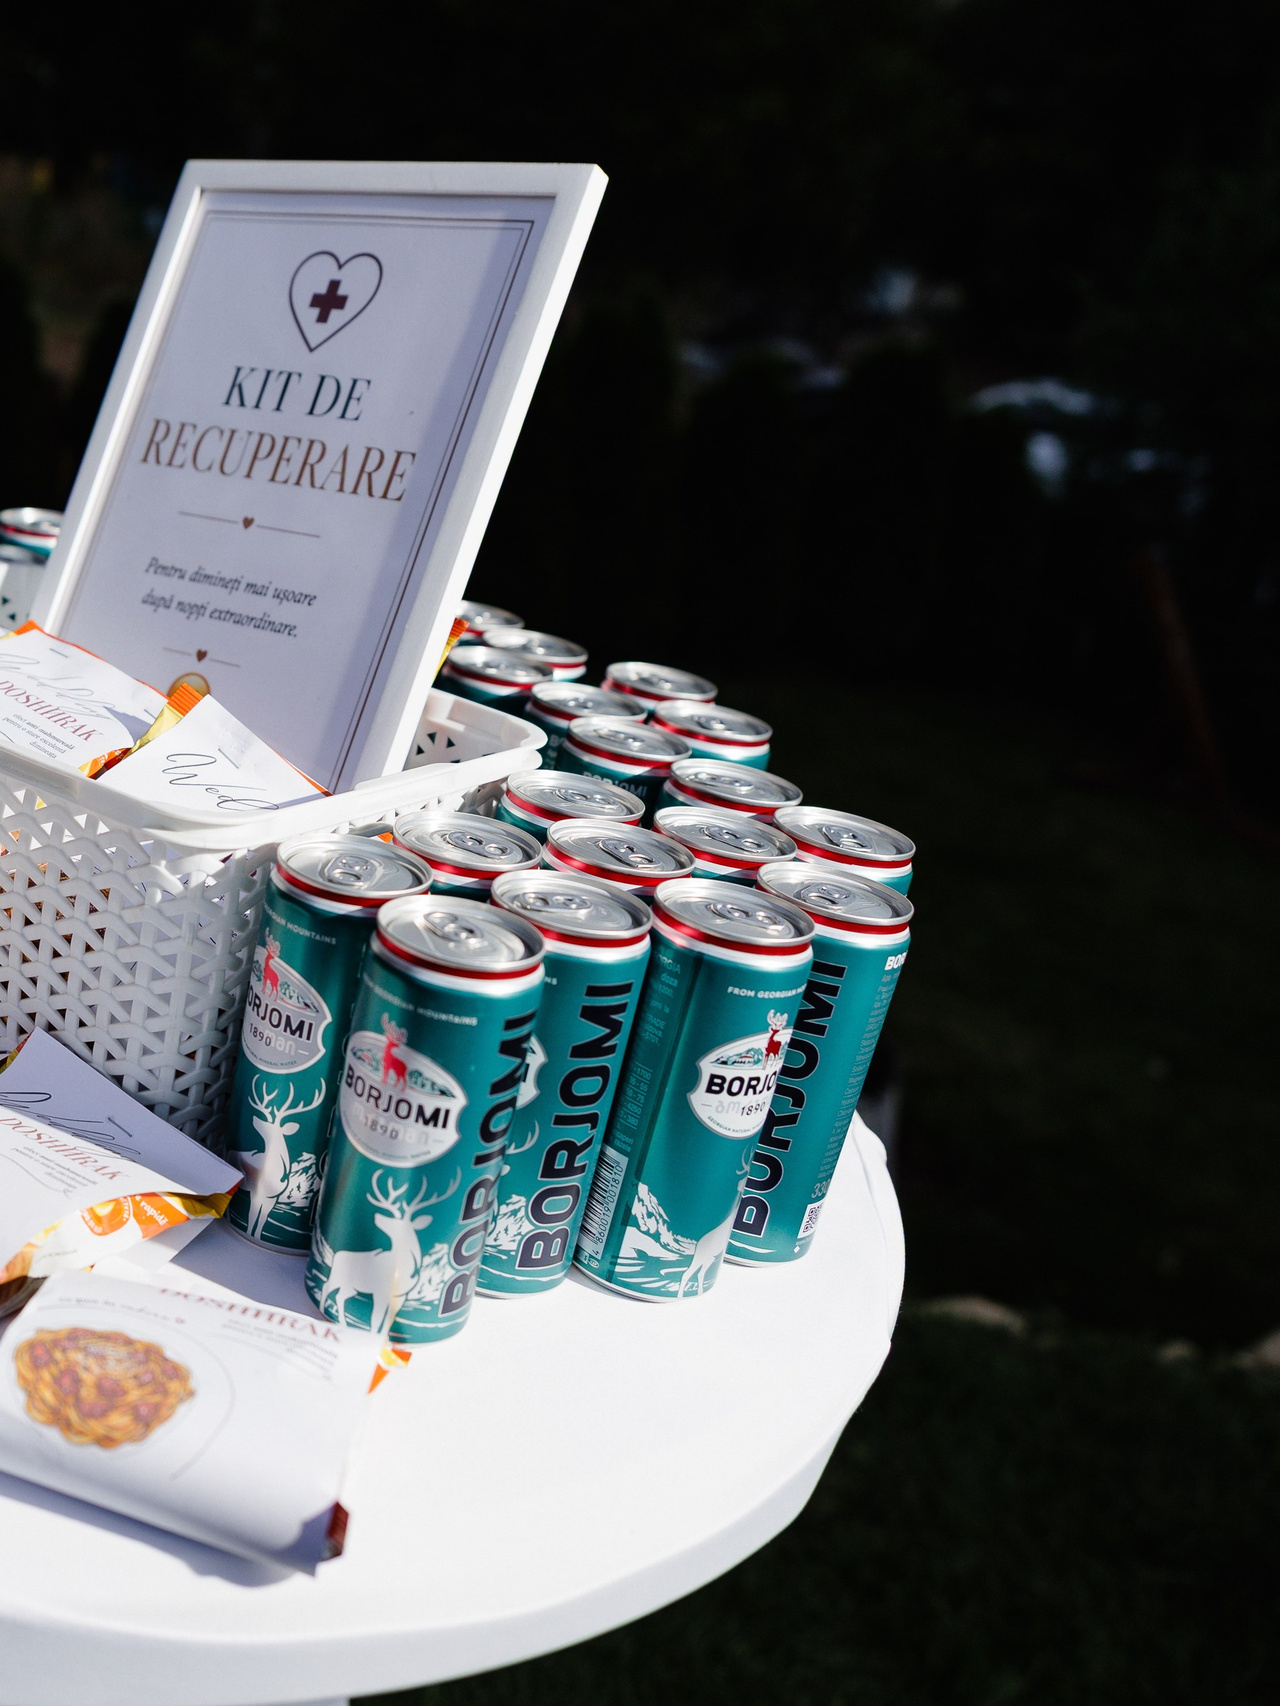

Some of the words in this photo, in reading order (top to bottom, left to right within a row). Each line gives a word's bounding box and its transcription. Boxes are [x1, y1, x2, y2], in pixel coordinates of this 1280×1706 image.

[223, 365, 302, 412] KIT
[306, 374, 372, 421] DE
[140, 418, 417, 502] RECUPERARE
[145, 556, 187, 580] Pentru
[189, 566, 244, 595] dimineți
[243, 580, 272, 597] mai
[272, 587, 317, 606] ușoare
[141, 589, 175, 613] după
[175, 598, 210, 620] nopți
[209, 606, 298, 638] extraordinare.
[286, 921, 337, 946] MOUNTAINS
[247, 980, 314, 1042] ORJOMI
[727, 985, 755, 998] FROM
[756, 987, 797, 999] GEORGIAN
[249, 1022, 272, 1047] 1890
[345, 1063, 450, 1129] BORJOMI
[705, 1070, 778, 1097] BORJO
[364, 1115, 399, 1141] 1890
[515, 980, 635, 1270] BORJOMI
[740, 1101, 766, 1117] 1890
[595, 1206, 612, 1244] 860019
[606, 1164, 624, 1204] 001810
